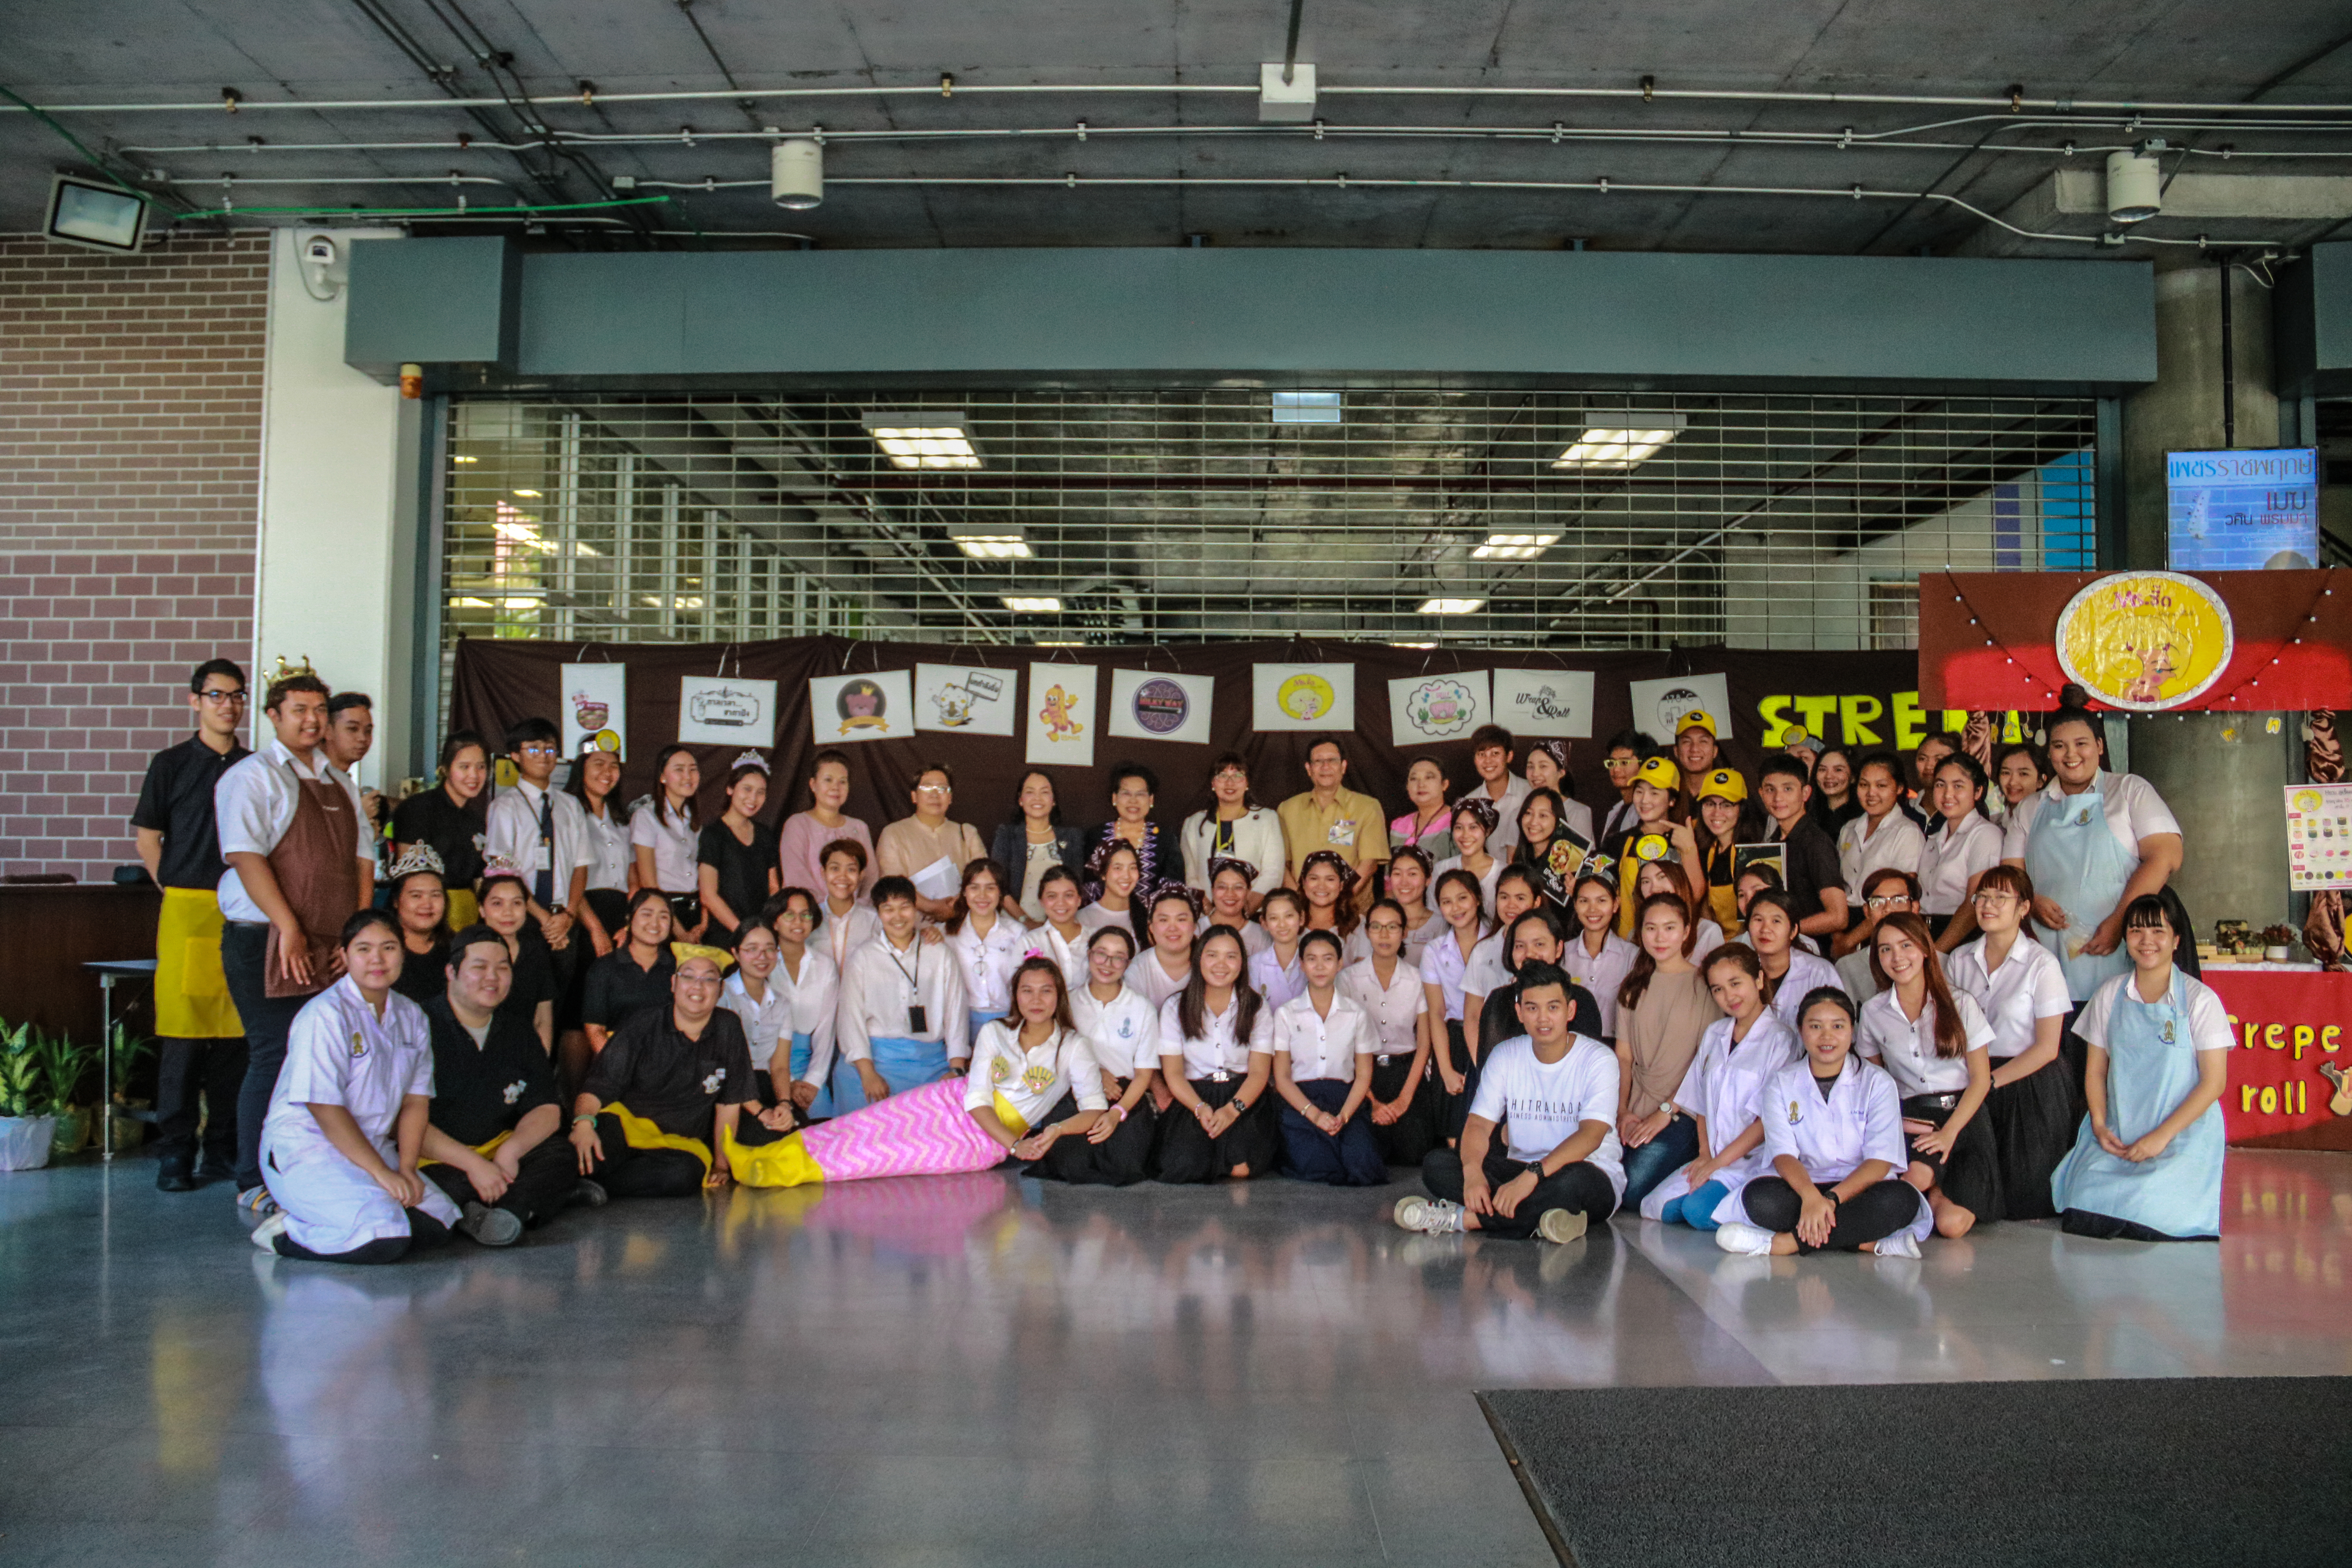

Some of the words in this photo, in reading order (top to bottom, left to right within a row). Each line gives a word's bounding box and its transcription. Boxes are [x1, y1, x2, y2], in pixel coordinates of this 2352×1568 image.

[2170, 451, 2313, 481] เพชรราชพฤกษ์
[1516, 693, 1541, 705] Wrap
[1536, 697, 1550, 715] &
[1548, 705, 1570, 719] Roll
[1504, 1097, 1581, 1114] HITRALADA
[2241, 1080, 2307, 1115] roll
[1508, 1112, 1531, 1120] SINESS
